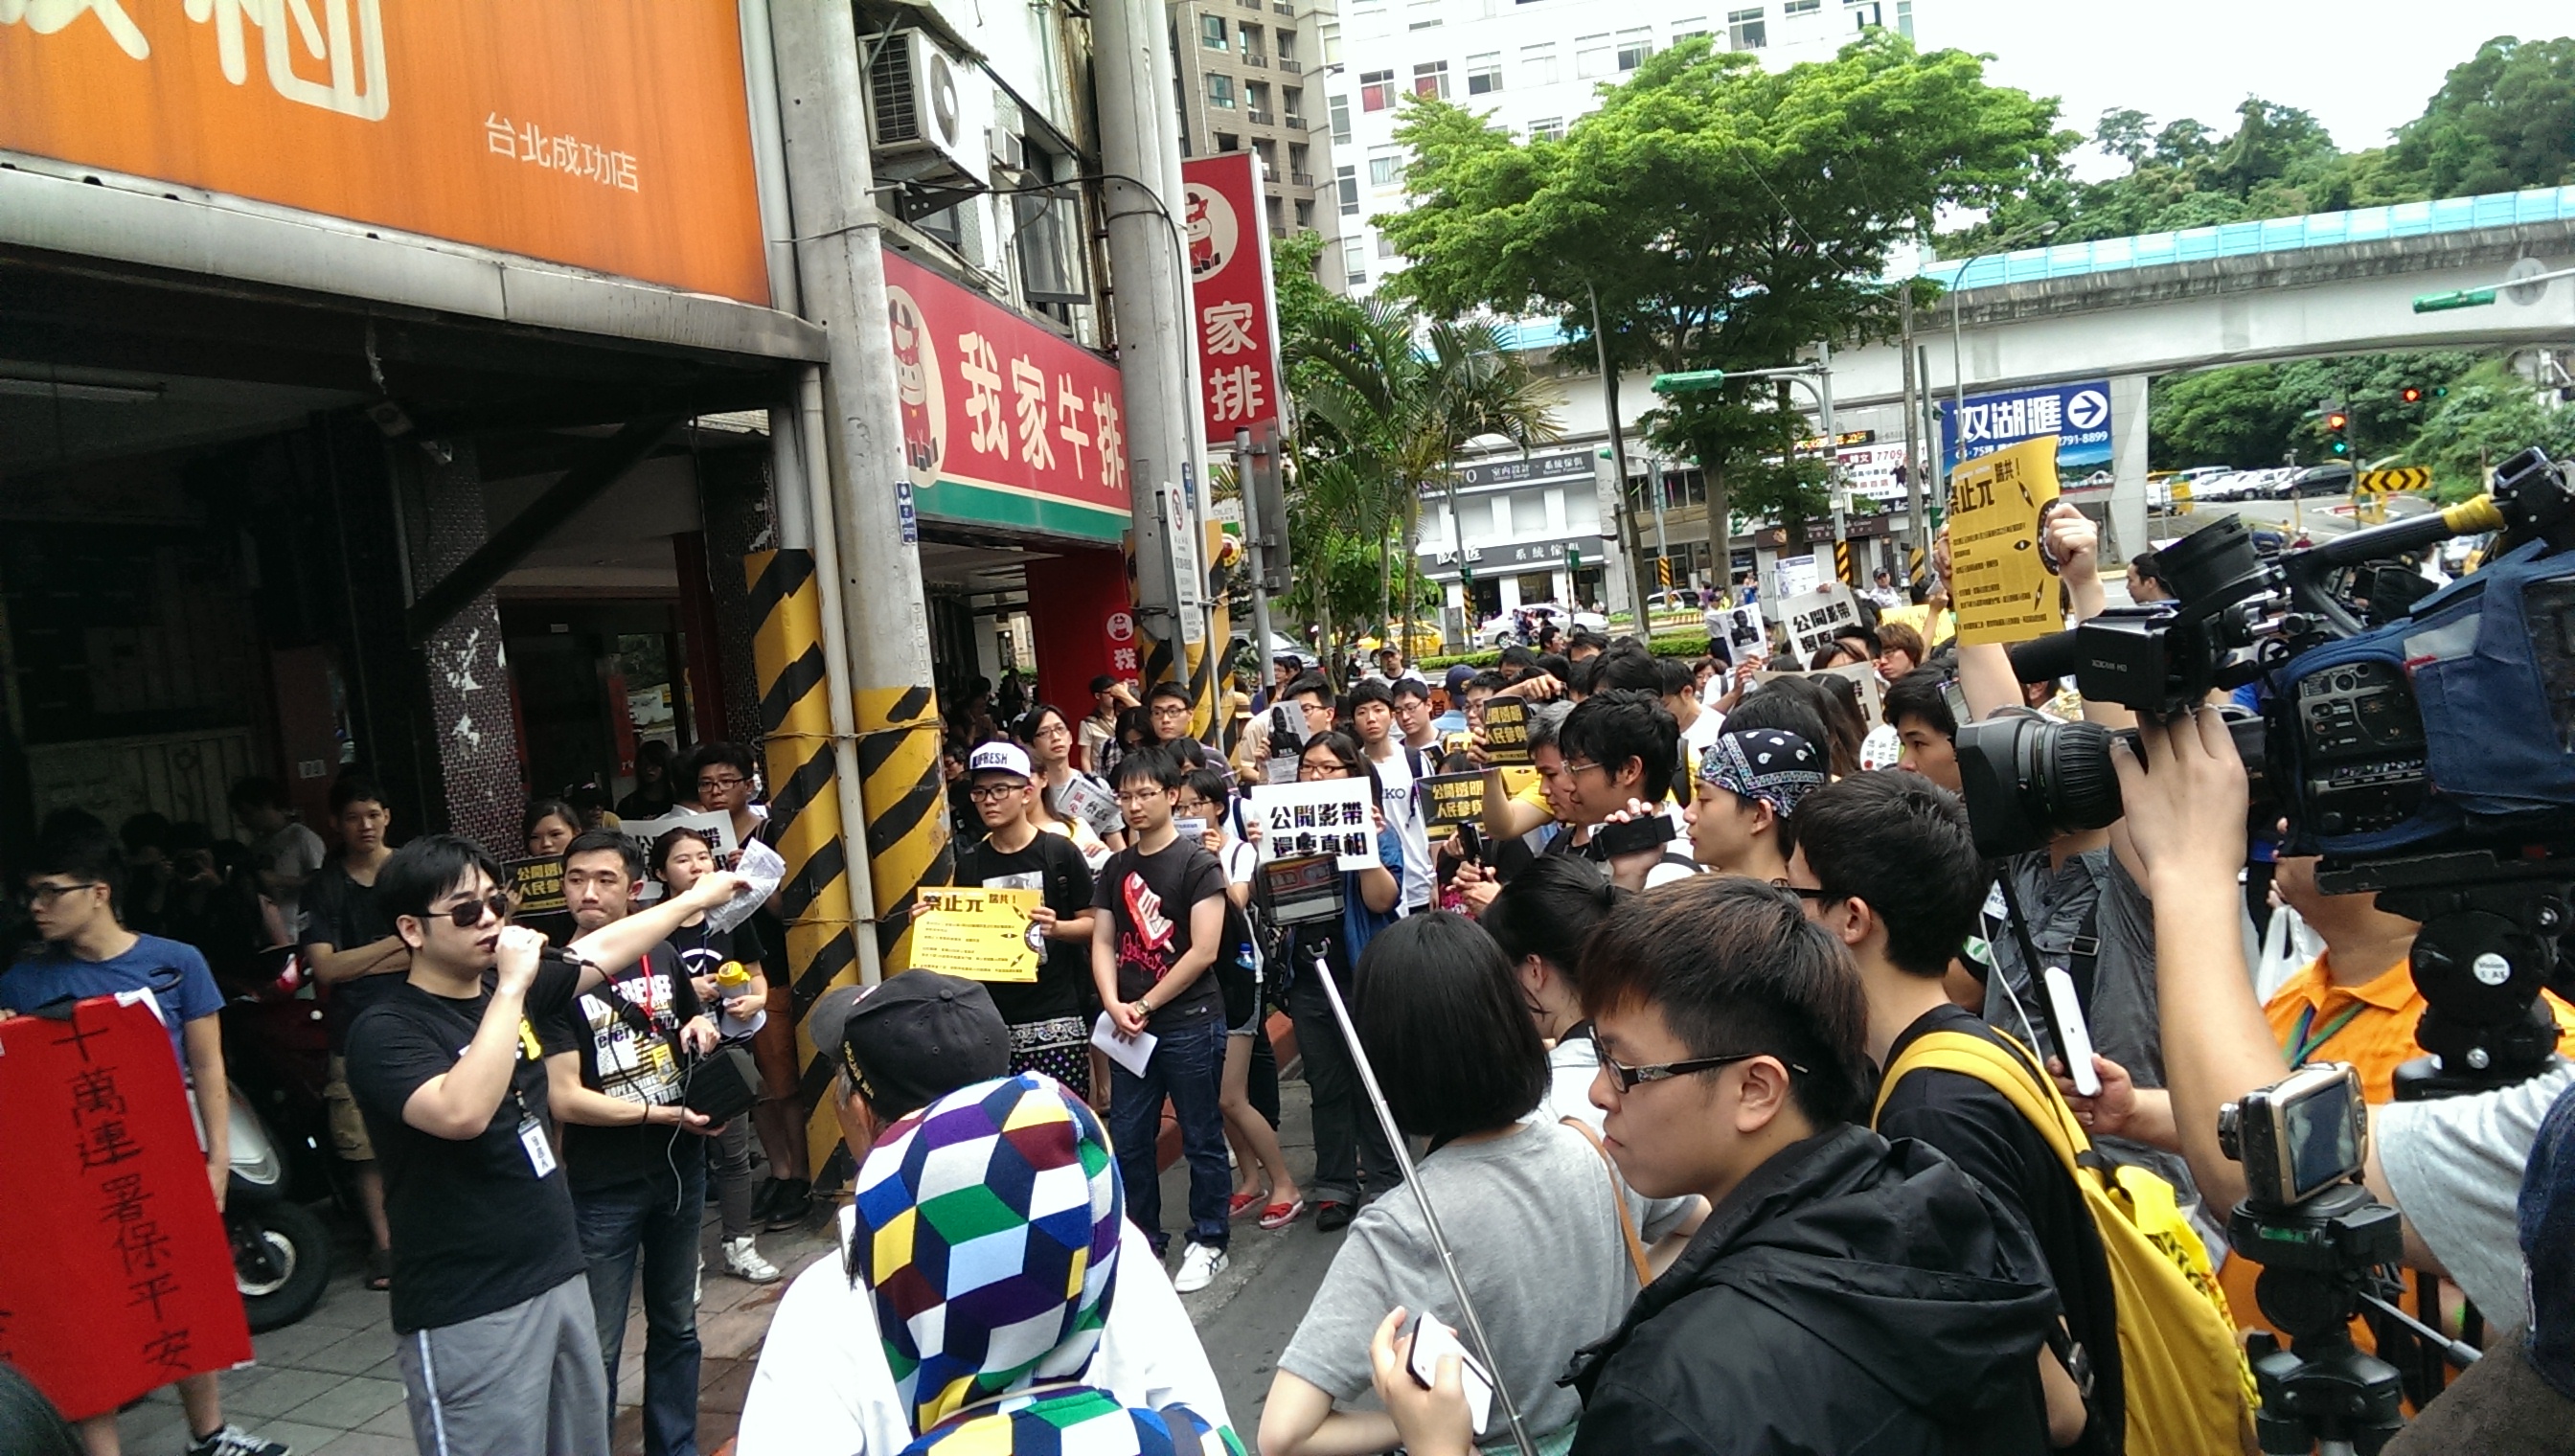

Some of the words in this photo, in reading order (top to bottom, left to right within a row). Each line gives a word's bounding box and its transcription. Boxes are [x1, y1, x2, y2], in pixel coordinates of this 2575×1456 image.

[485, 111, 639, 193] 台北成功店
[959, 331, 1124, 490] 我家牛排
[1270, 801, 1363, 830] 公開影帶
[53, 1013, 192, 1371] 十萬連署保平安
